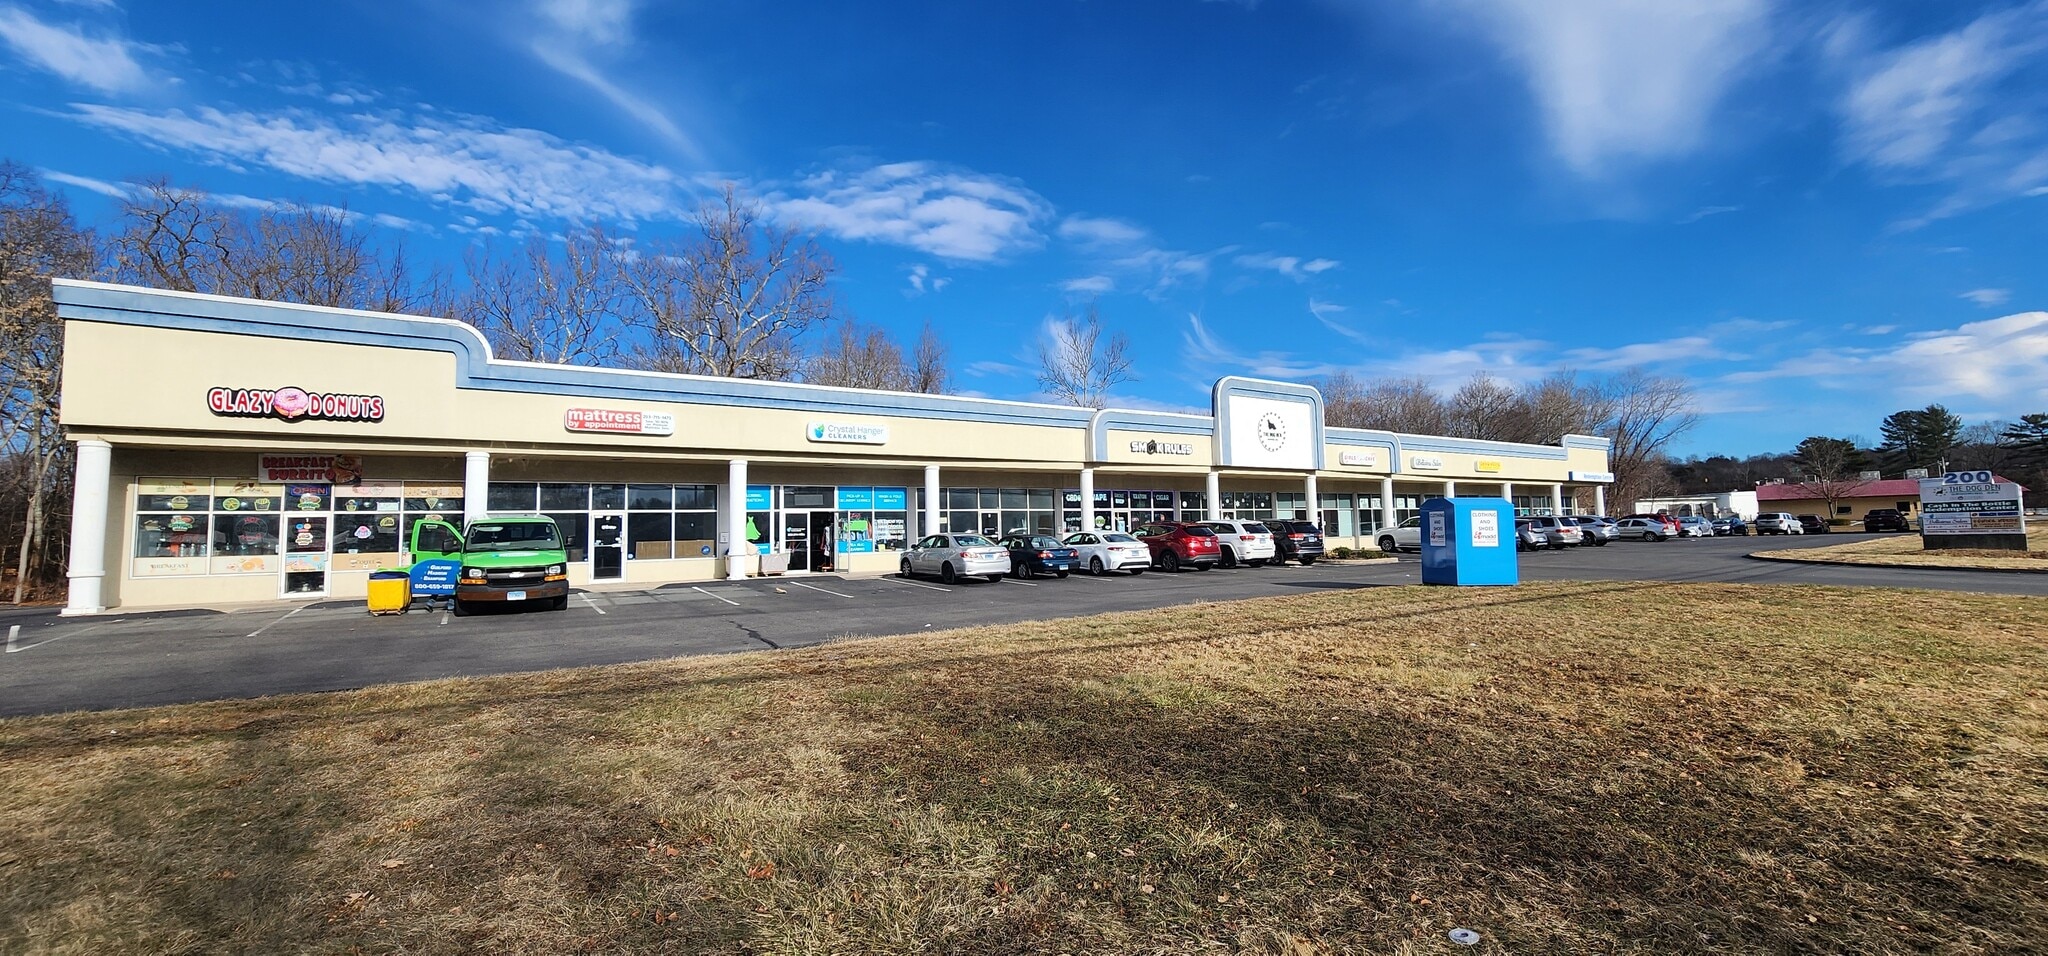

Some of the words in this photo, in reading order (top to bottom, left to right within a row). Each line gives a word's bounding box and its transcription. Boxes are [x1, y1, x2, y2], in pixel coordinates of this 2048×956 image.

[211, 388, 275, 413] GLAZY
[308, 394, 383, 419] DONUTS
[568, 410, 641, 424] mattress
[568, 420, 579, 428] by
[584, 421, 641, 430] appointment
[828, 424, 856, 434] Crystal
[857, 426, 884, 436] Hanger
[262, 456, 334, 468] BREAKFAST
[268, 468, 336, 480] BURRITO
[1944, 472, 1990, 484] 200
